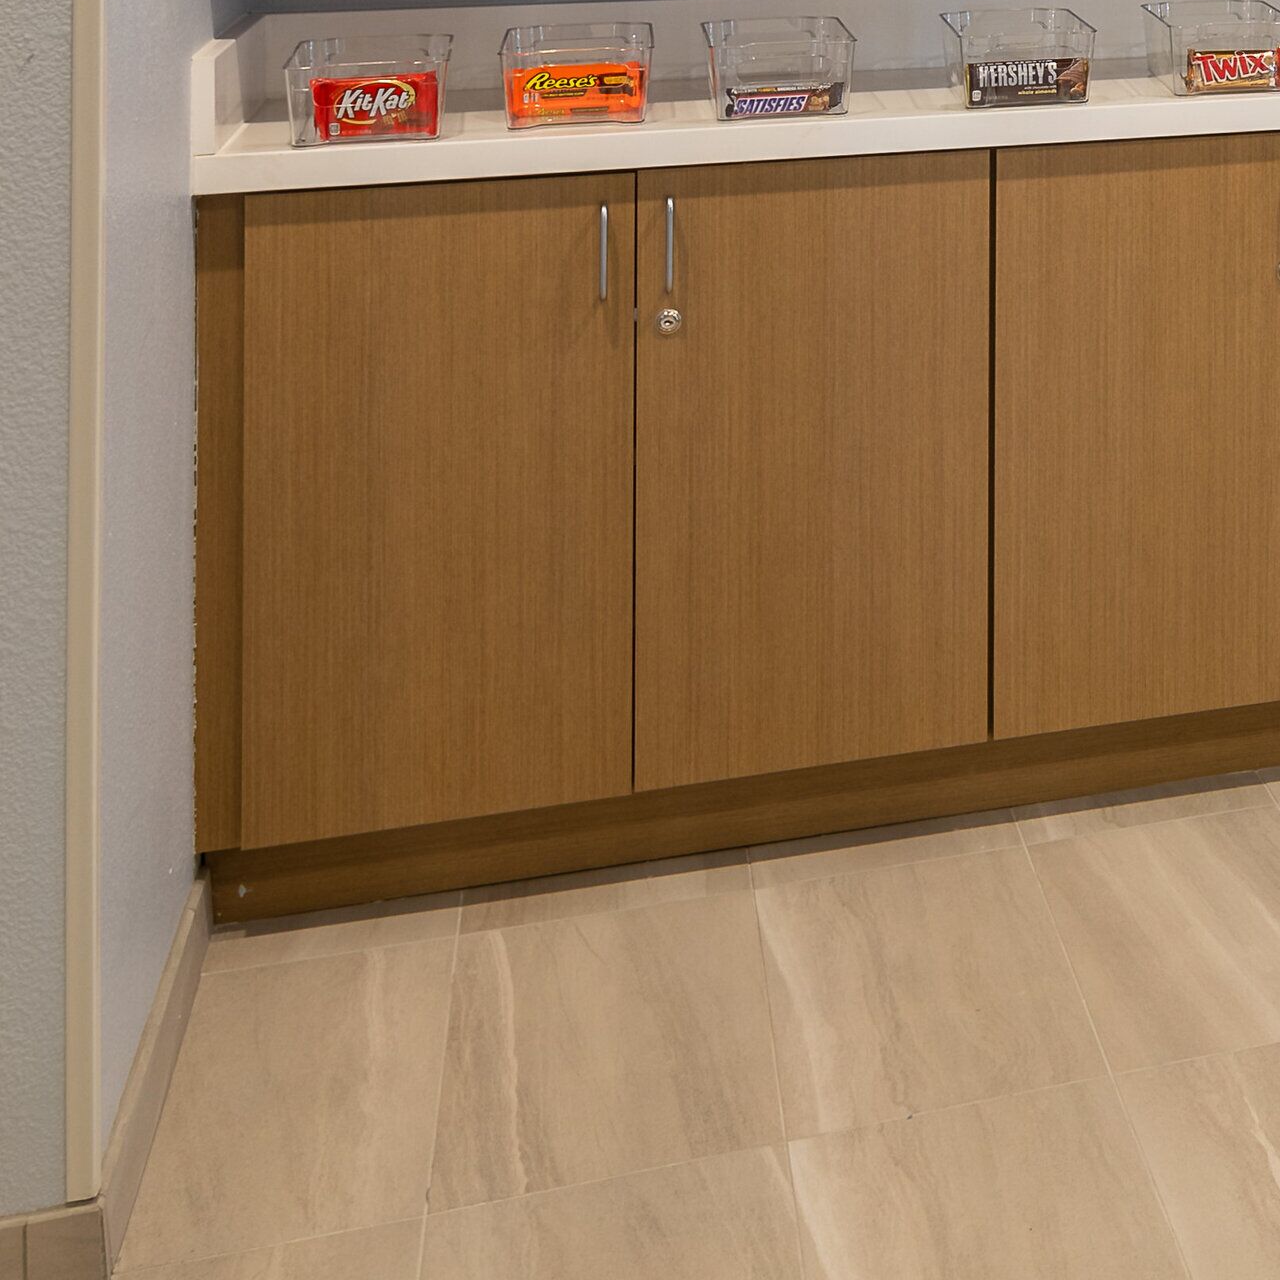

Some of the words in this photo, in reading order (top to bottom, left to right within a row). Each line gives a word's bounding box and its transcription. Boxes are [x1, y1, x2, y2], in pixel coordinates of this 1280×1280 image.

[979, 62, 1058, 88] HERSHEY'S
[1192, 51, 1271, 85] Twix
[523, 72, 598, 91] Reese's
[735, 95, 806, 115] SATISFIES
